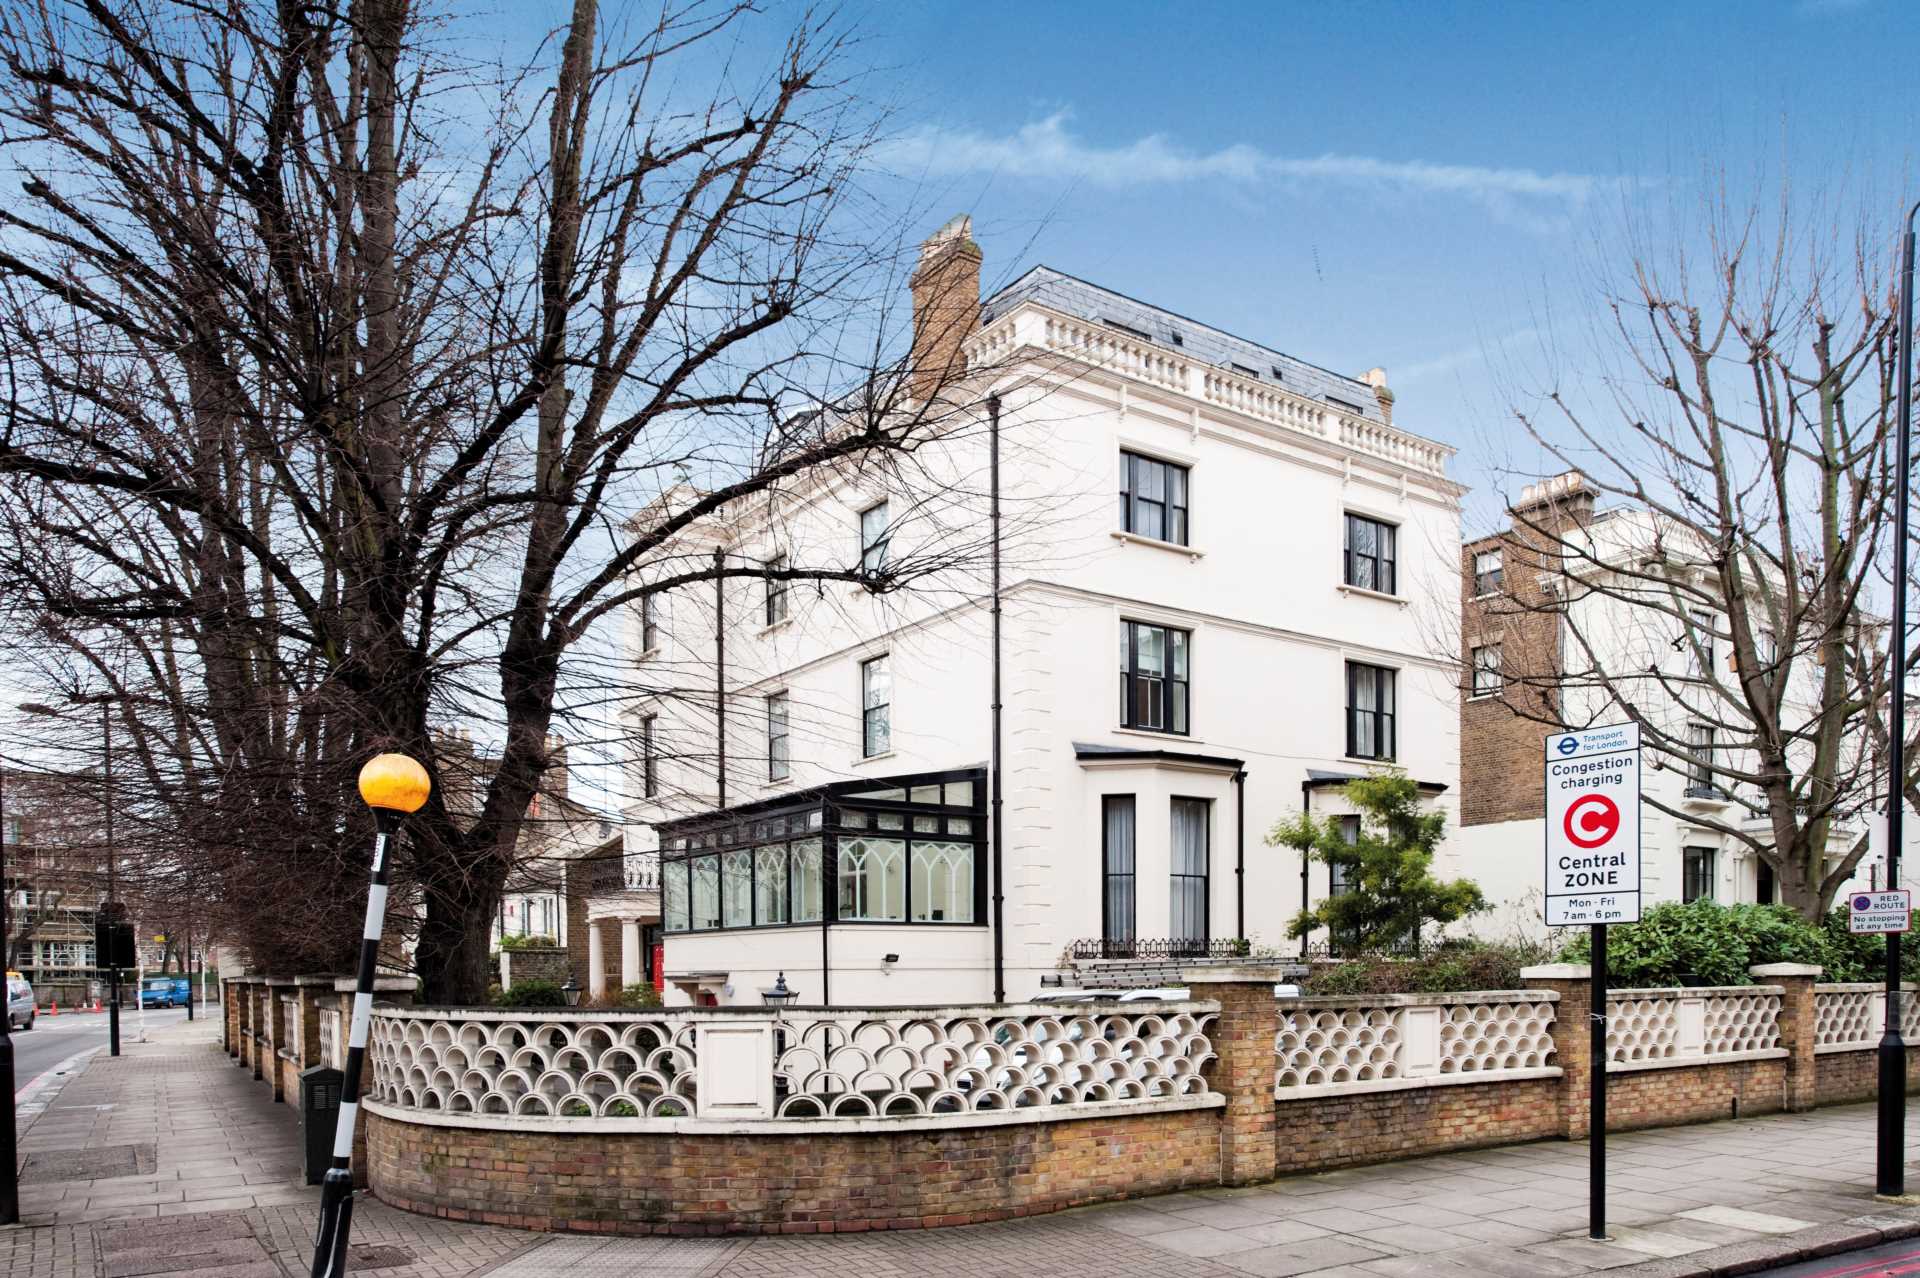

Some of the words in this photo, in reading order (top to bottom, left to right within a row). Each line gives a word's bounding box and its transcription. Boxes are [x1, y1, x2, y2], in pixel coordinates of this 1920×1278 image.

[1583, 731, 1623, 742] Transport
[1597, 739, 1628, 750] London
[1552, 757, 1632, 776] Congestion
[1561, 773, 1622, 789] charging
[1559, 851, 1626, 870] Central
[1565, 871, 1618, 887] ZONE
[1569, 899, 1592, 908] Mon
[1601, 897, 1615, 906] Fri
[1868, 914, 1906, 922] stopping
